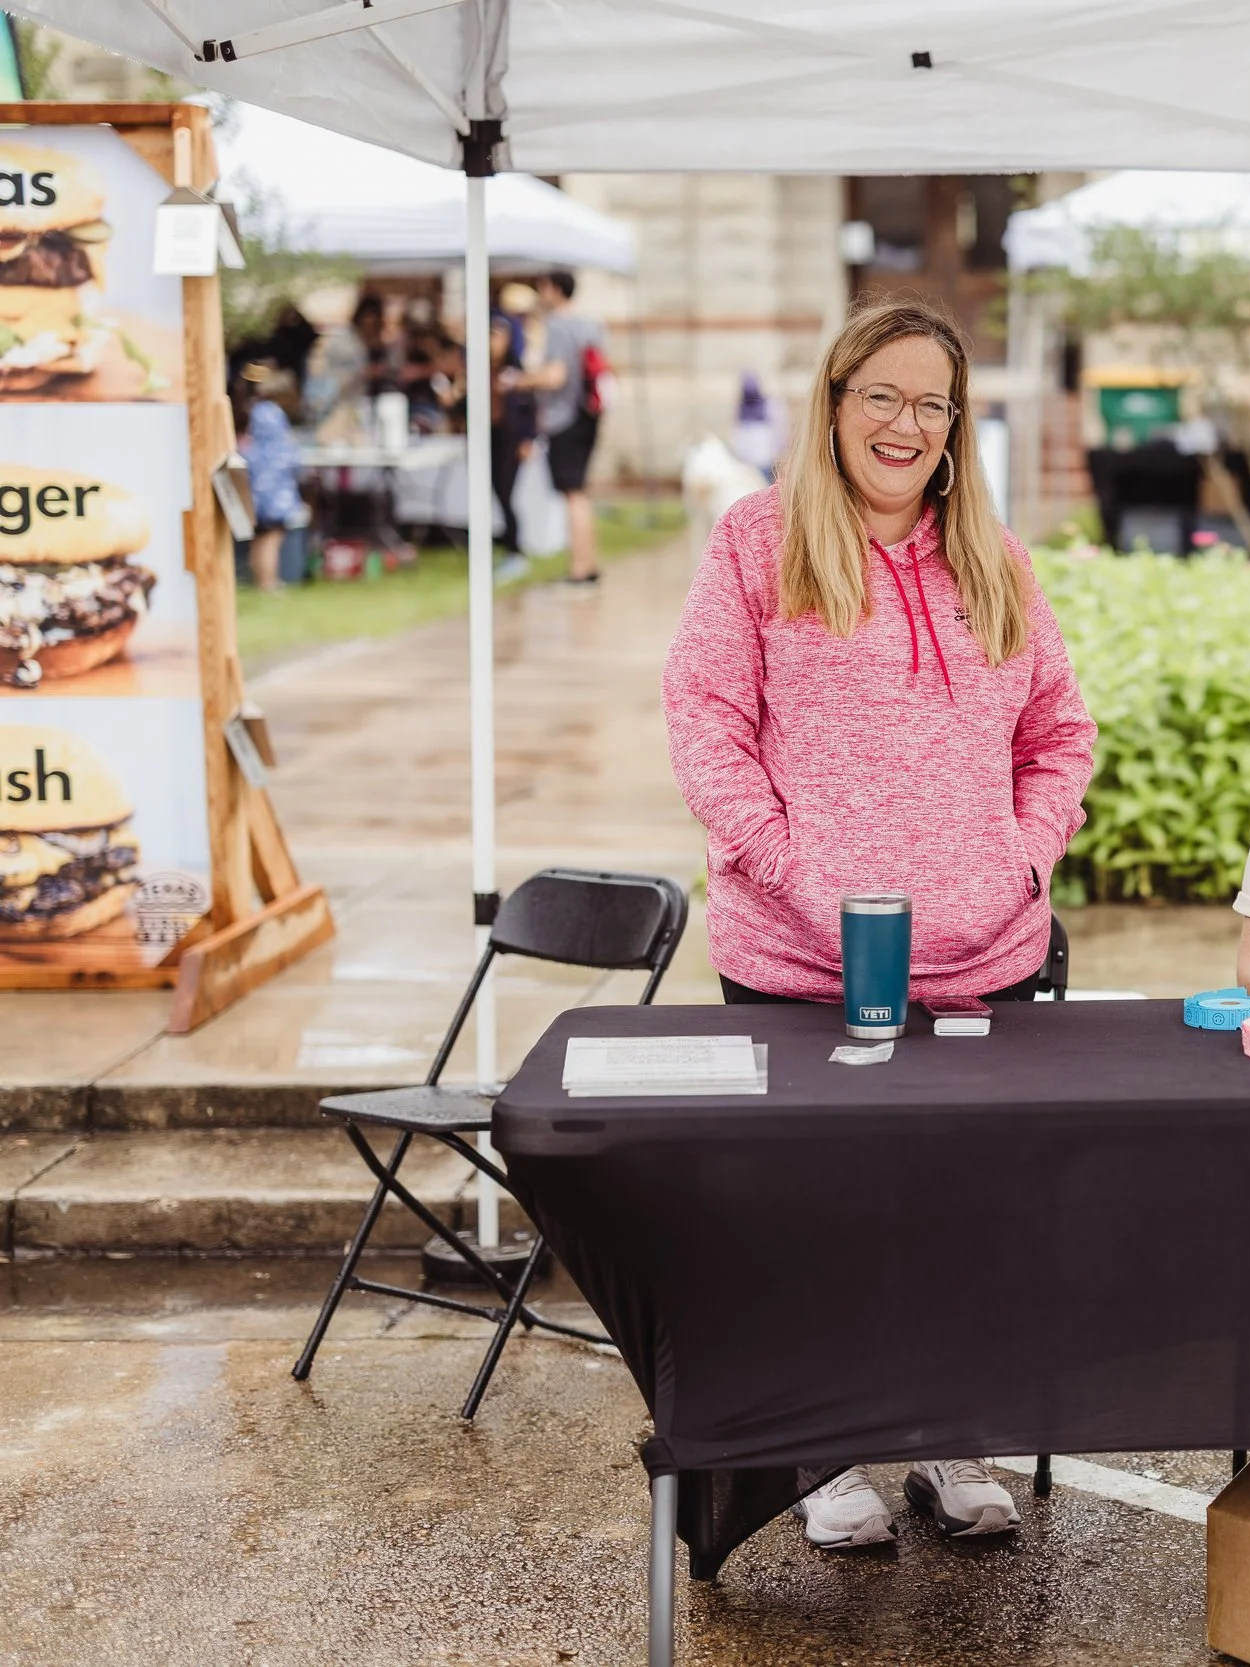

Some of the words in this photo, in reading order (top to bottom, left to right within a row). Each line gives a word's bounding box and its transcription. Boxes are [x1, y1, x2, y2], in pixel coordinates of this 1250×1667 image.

[0, 171, 56, 206] as
[0, 485, 100, 535] ger
[862, 1009, 890, 1019] YETI
